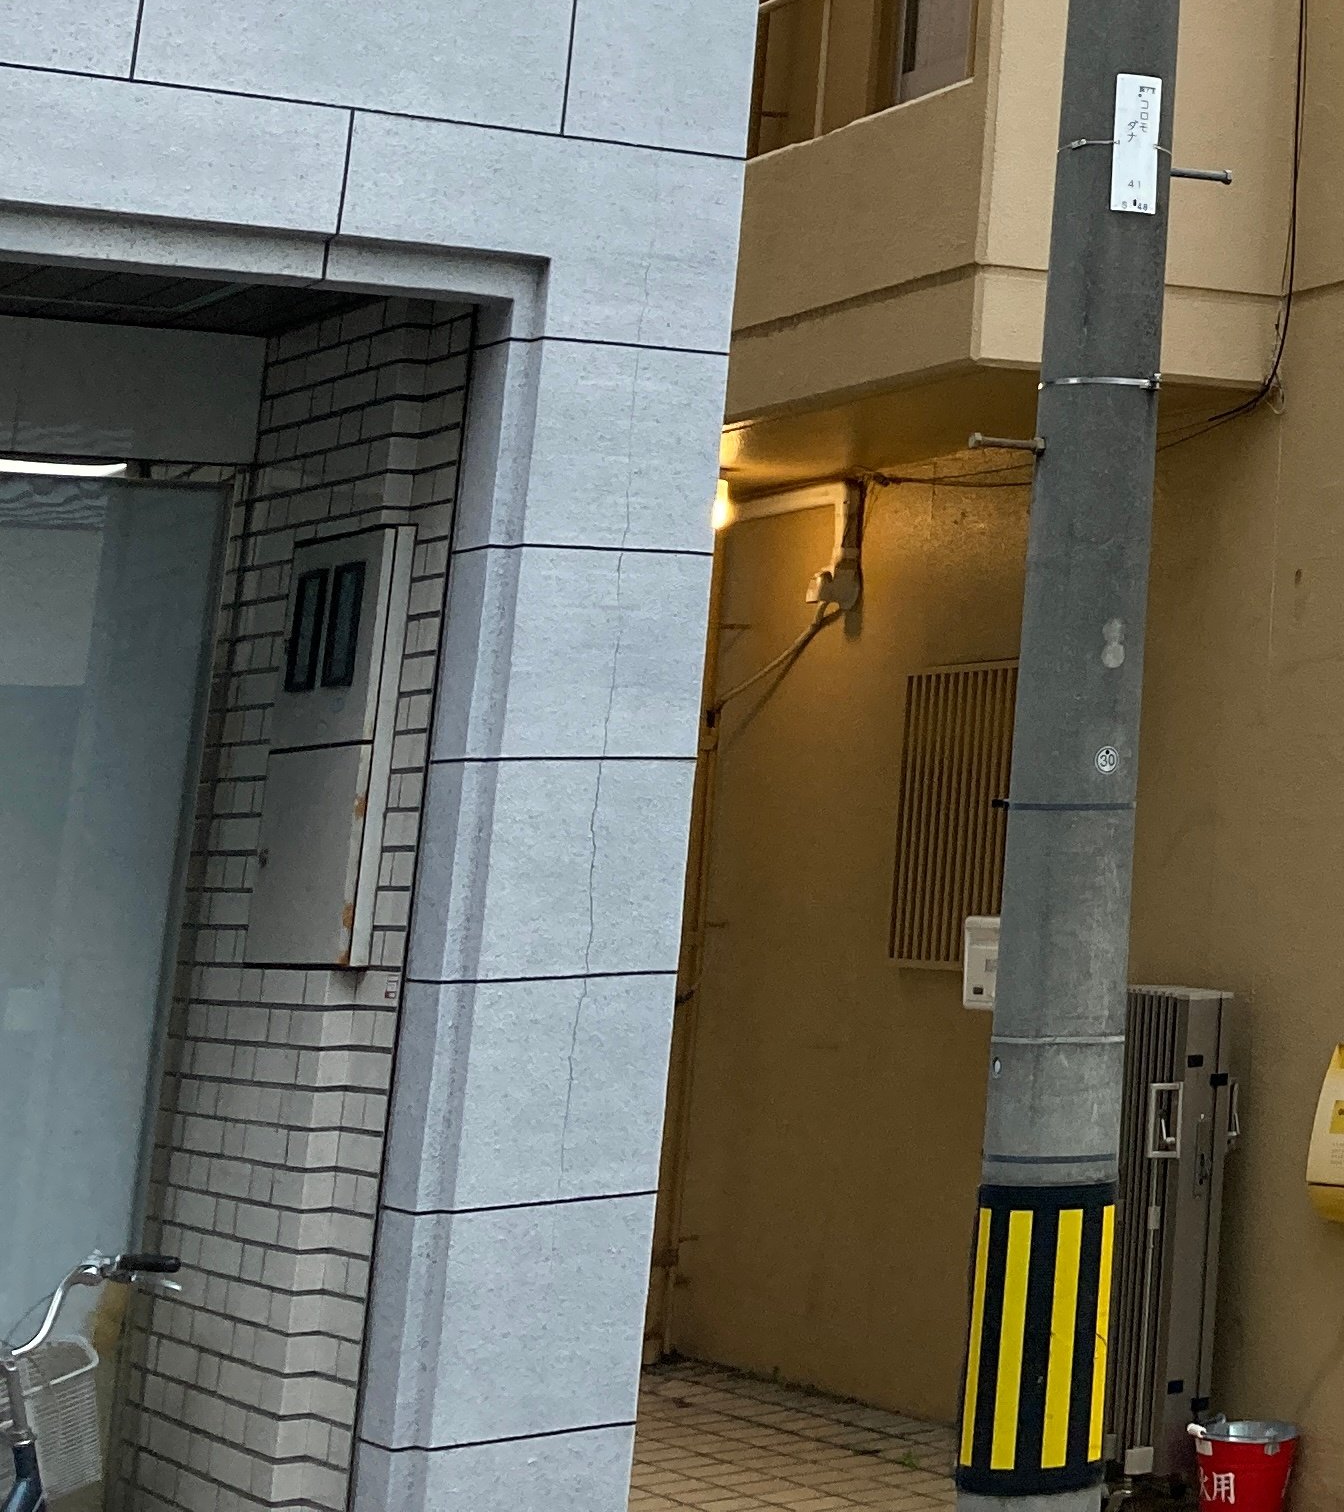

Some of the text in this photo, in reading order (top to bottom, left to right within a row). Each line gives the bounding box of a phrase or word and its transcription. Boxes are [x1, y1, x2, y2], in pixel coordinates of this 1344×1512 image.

[1139, 99, 1149, 133] コロモ
[1126, 119, 1139, 143] ダナ
[1100, 754, 1115, 767] 30
